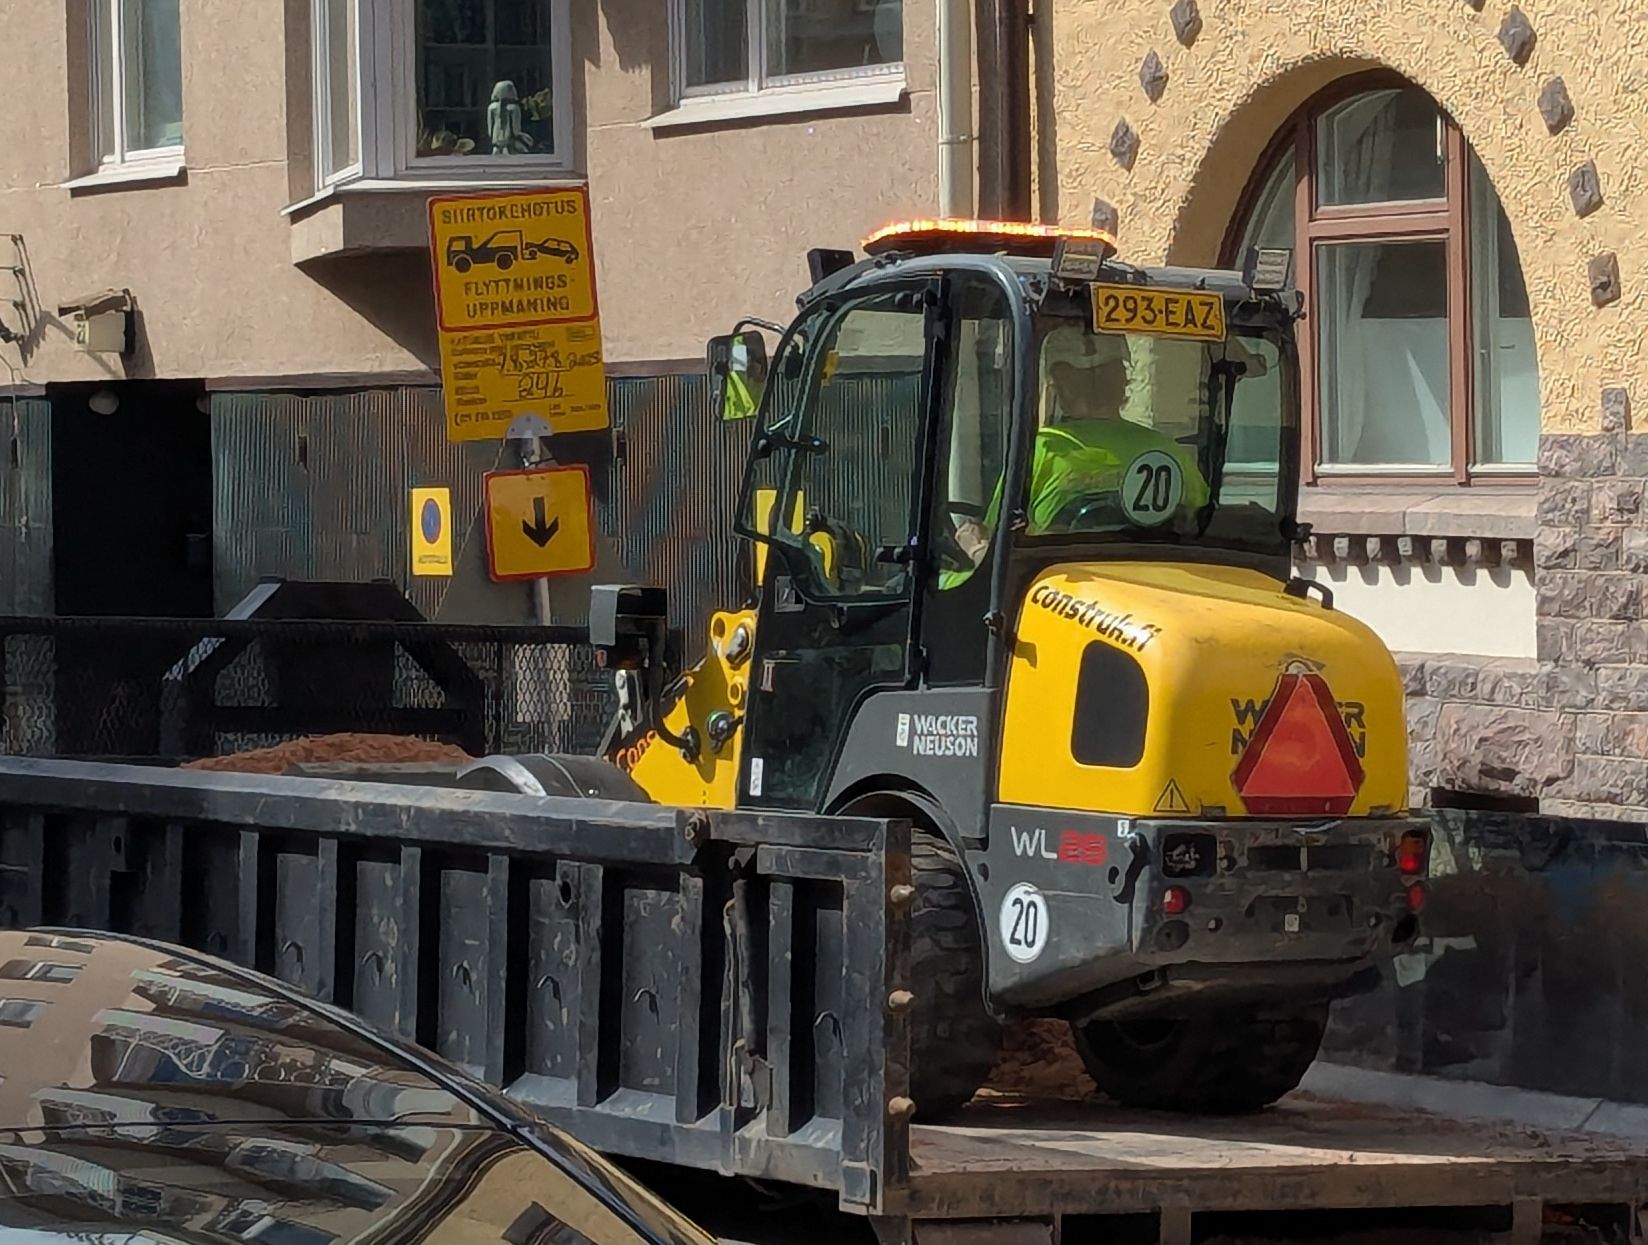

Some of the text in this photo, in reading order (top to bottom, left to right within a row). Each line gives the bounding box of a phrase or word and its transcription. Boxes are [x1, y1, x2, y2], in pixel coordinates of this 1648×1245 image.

[442, 200, 577, 225] SIIRTOKEHOTUS
[466, 296, 570, 319] UPPMANING
[1104, 294, 1216, 331] 293-EAZ
[1132, 464, 1172, 513] 20
[913, 714, 978, 736] WACKER
[913, 735, 978, 757] NEUSON
[1009, 897, 1038, 949] 20
